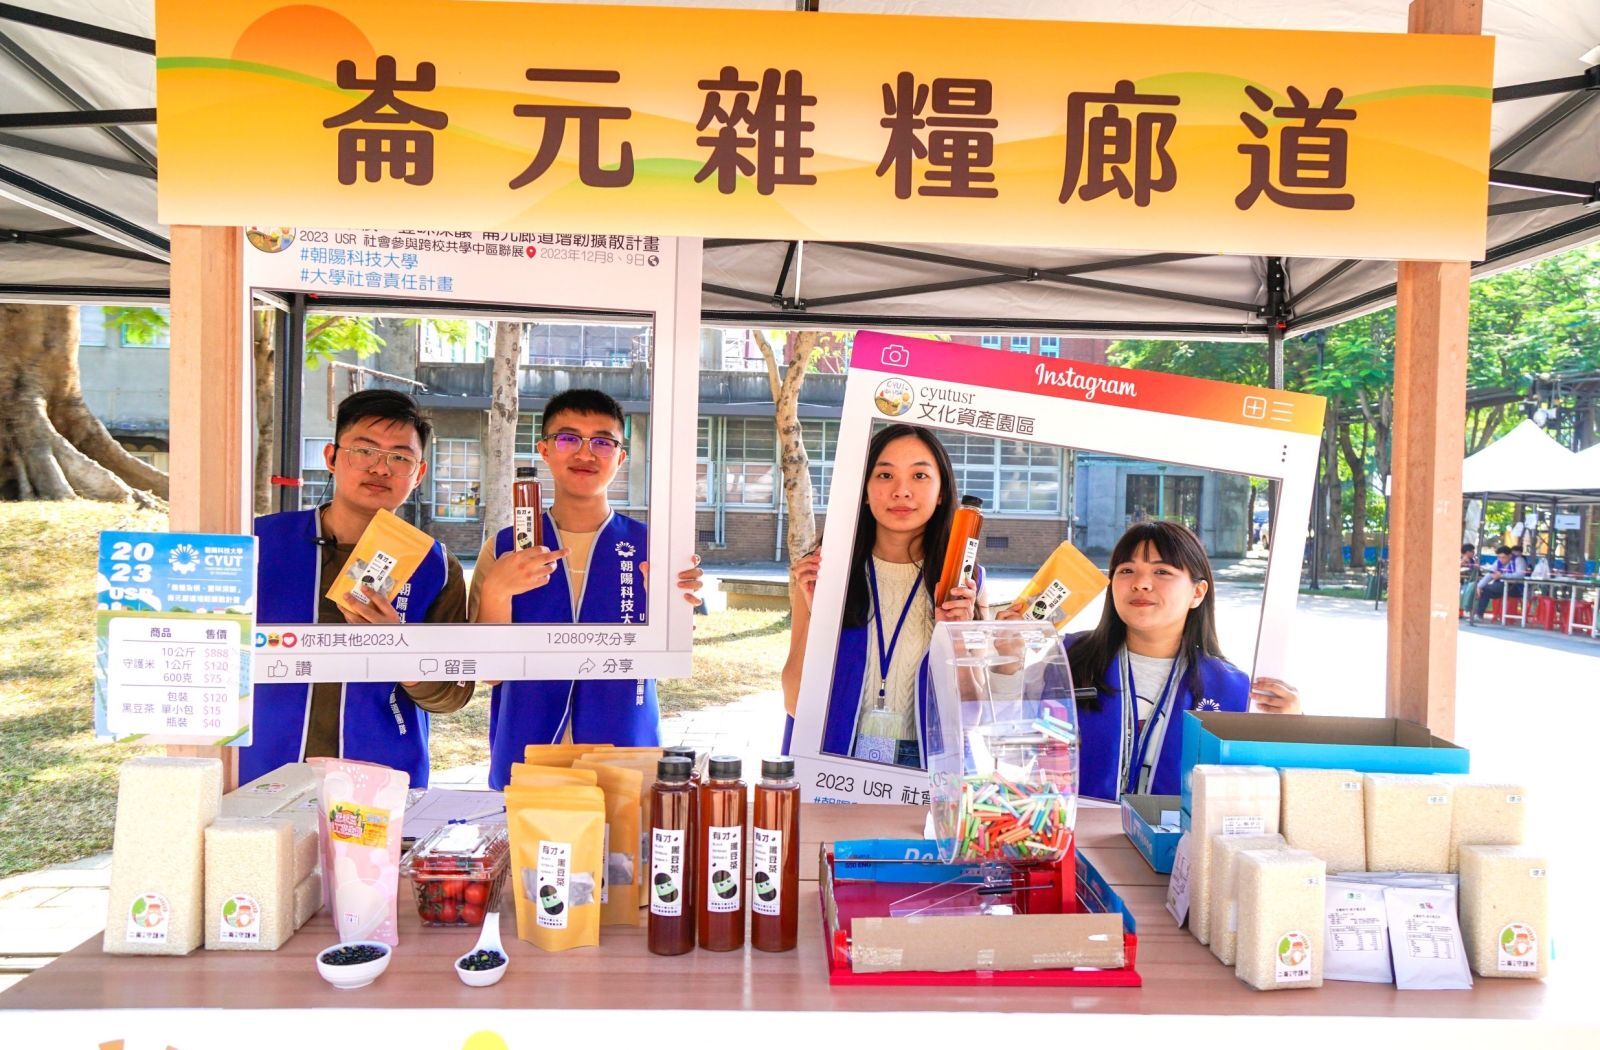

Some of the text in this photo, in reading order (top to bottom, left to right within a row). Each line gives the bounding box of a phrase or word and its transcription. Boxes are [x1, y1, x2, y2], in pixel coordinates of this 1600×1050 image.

[322, 54, 1357, 212] 崙元雜糧廊道
[299, 230, 329, 244] 2023
[334, 233, 357, 246] USR
[363, 234, 525, 258] 社會參與跨校共學中區聯展
[299, 246, 419, 270] #朝陽科技大學
[299, 267, 455, 293] #大學社會責任計畫
[1034, 362, 1138, 400] Instagram
[920, 385, 976, 405] cyutusr
[917, 402, 1036, 436] 文化資產園區
[110, 541, 155, 562] 20
[204, 555, 244, 568] CYUT
[109, 562, 153, 583] 23
[150, 627, 228, 640] 商品 售價
[300, 632, 409, 648] 你和其他2023人
[546, 632, 637, 646] 120809次分享
[161, 647, 229, 658] 10公斤 $888
[122, 658, 229, 671] 守護米 1公斤 $120
[295, 658, 634, 677] 讚 留言 分享
[163, 672, 222, 684] 600克 $75
[167, 691, 228, 703] 包裝 $120
[122, 703, 222, 716] 黑豆茶 單小包 $15
[166, 717, 221, 728] 瓶裝 $40
[815, 772, 855, 793] 2023
[863, 779, 893, 800] USR
[655, 833, 672, 843] 有才
[712, 831, 731, 841] 有才
[755, 832, 770, 843] 有才
[542, 845, 558, 856] 有才
